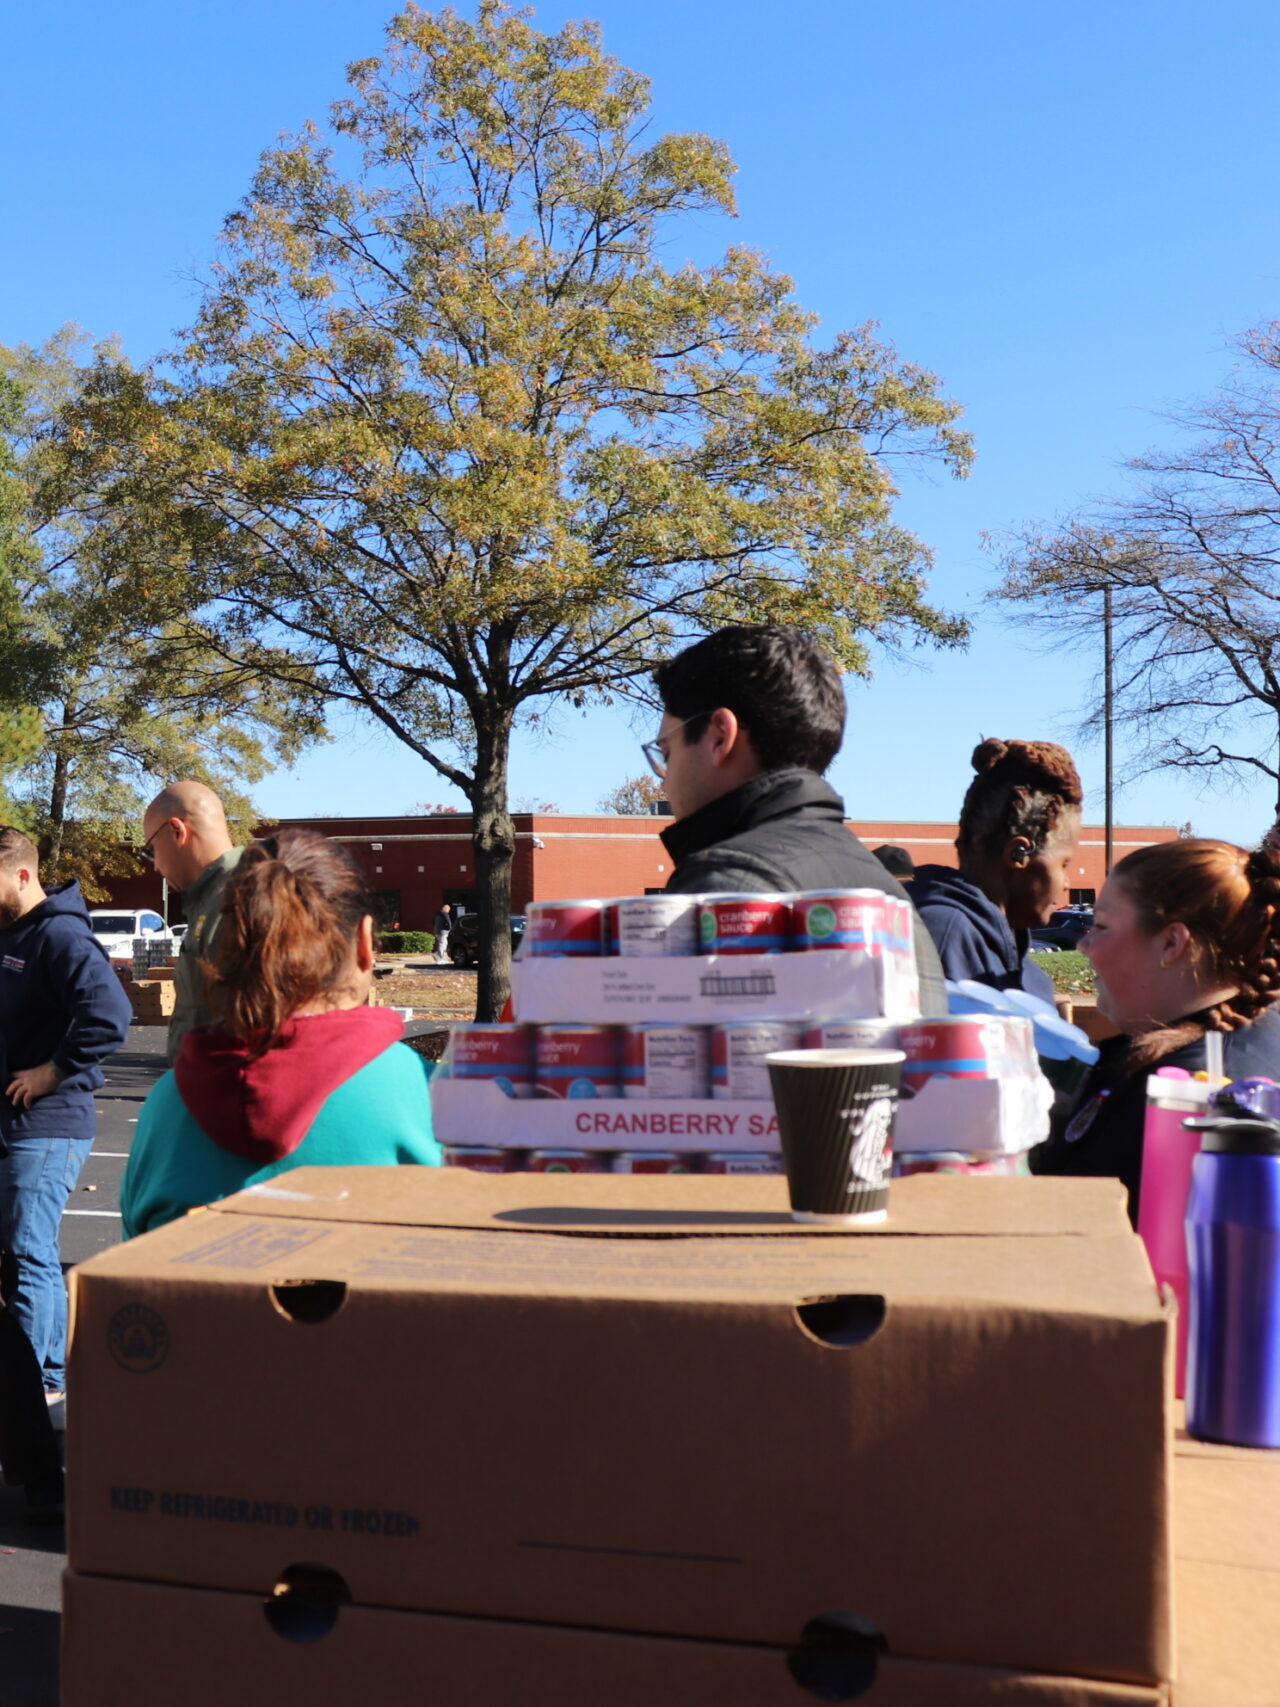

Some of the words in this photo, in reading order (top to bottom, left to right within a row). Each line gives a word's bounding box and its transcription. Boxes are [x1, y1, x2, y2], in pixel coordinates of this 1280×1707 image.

[720, 909, 773, 924] cranberry
[720, 923, 753, 933] sauce
[575, 1112, 740, 1136] CRANBERRY
[110, 1486, 155, 1513] KEEP
[160, 1491, 298, 1528] REFRIGERATED
[304, 1504, 334, 1531] OR
